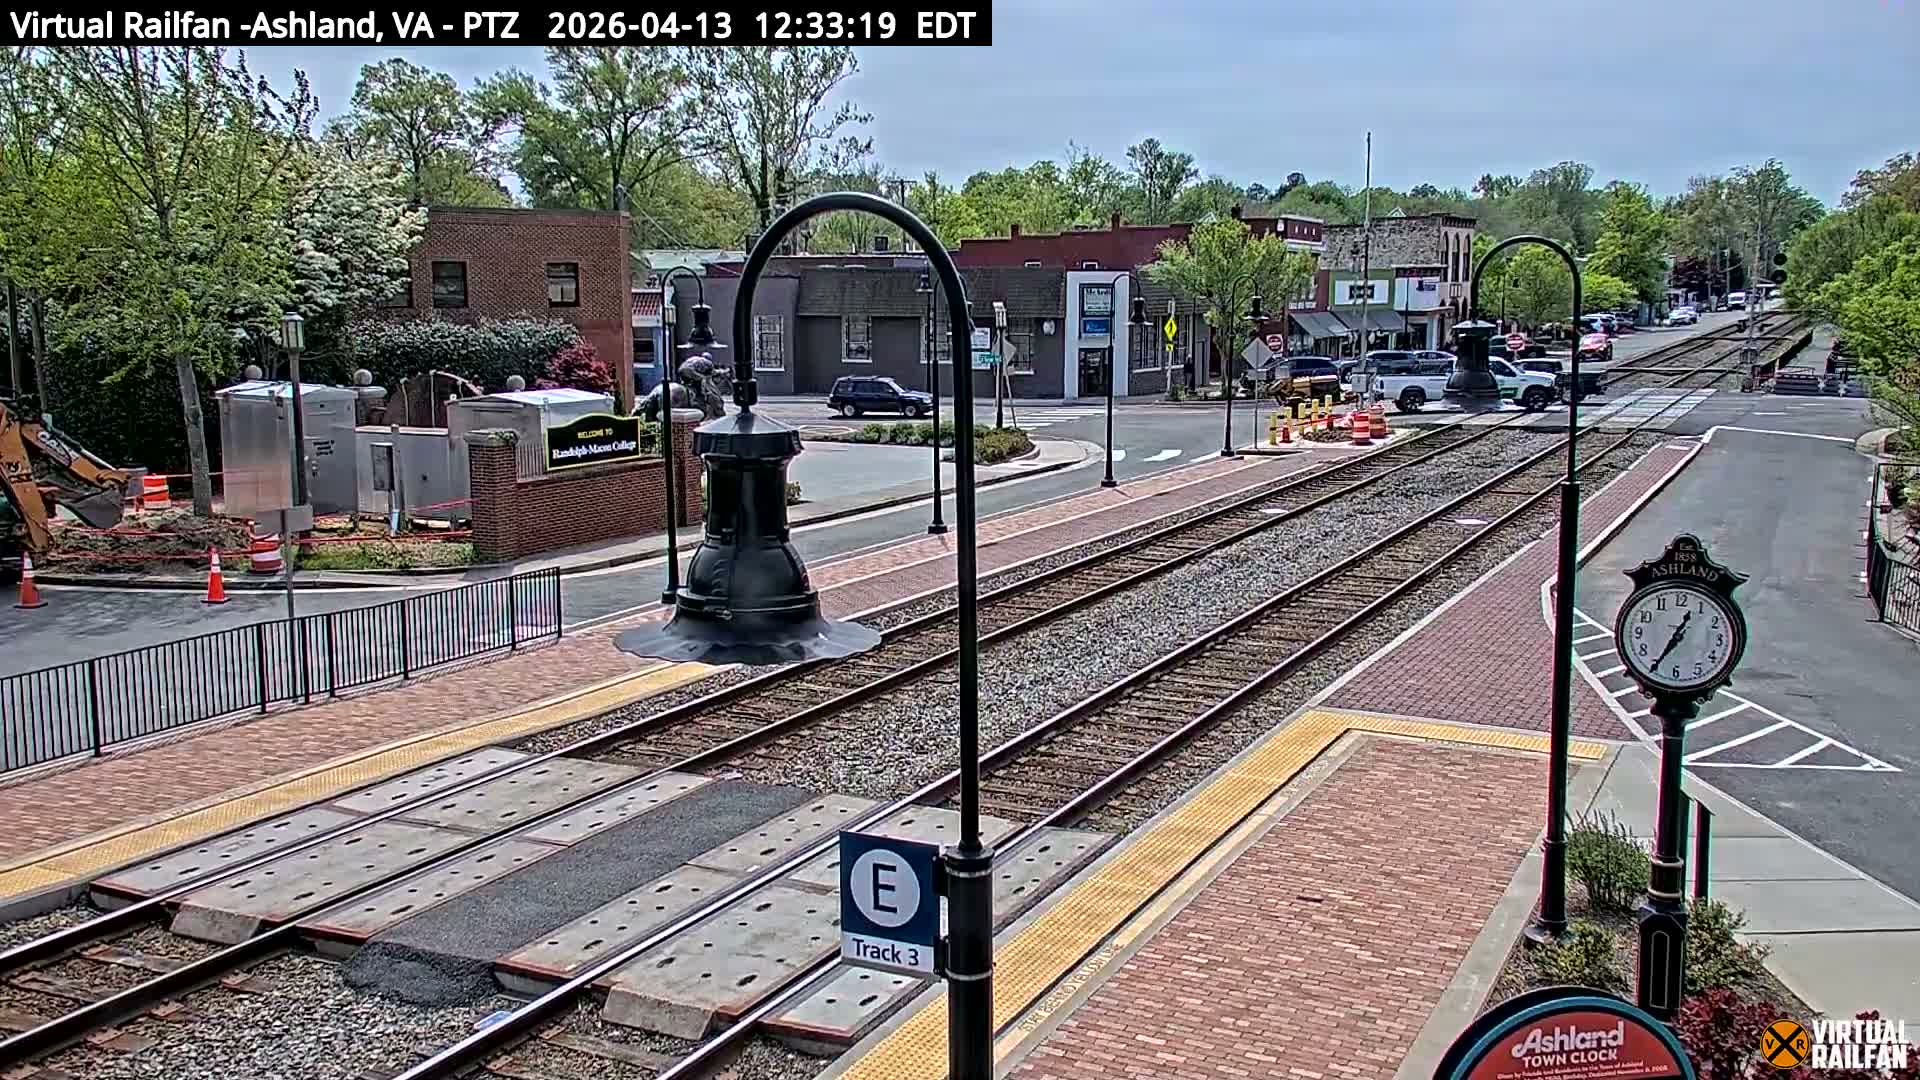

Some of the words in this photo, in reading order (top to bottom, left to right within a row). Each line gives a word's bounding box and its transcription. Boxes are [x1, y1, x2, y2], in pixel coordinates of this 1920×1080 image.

[552, 444, 612, 459] Randolph-Macon
[612, 440, 636, 451] College
[1652, 562, 1719, 581] ASHLAND
[1657, 597, 1666, 611] 11
[1675, 594, 1688, 607] 12
[1699, 602, 1704, 614] 1
[1640, 610, 1652, 623] 10
[1711, 616, 1719, 629] 2
[1634, 627, 1643, 639] 9
[1716, 634, 1723, 647] 3
[1639, 643, 1648, 656] 8
[1708, 650, 1716, 664] 4
[1672, 665, 1680, 678] 6
[1693, 663, 1702, 676] 5
[872, 863, 898, 914] E
[852, 938, 902, 964] Track
[908, 948, 919, 966] 3
[1511, 1020, 1624, 1058] Ashland
[1523, 1053, 1566, 1068] TOWN
[1570, 1048, 1618, 1064] CLOCK
